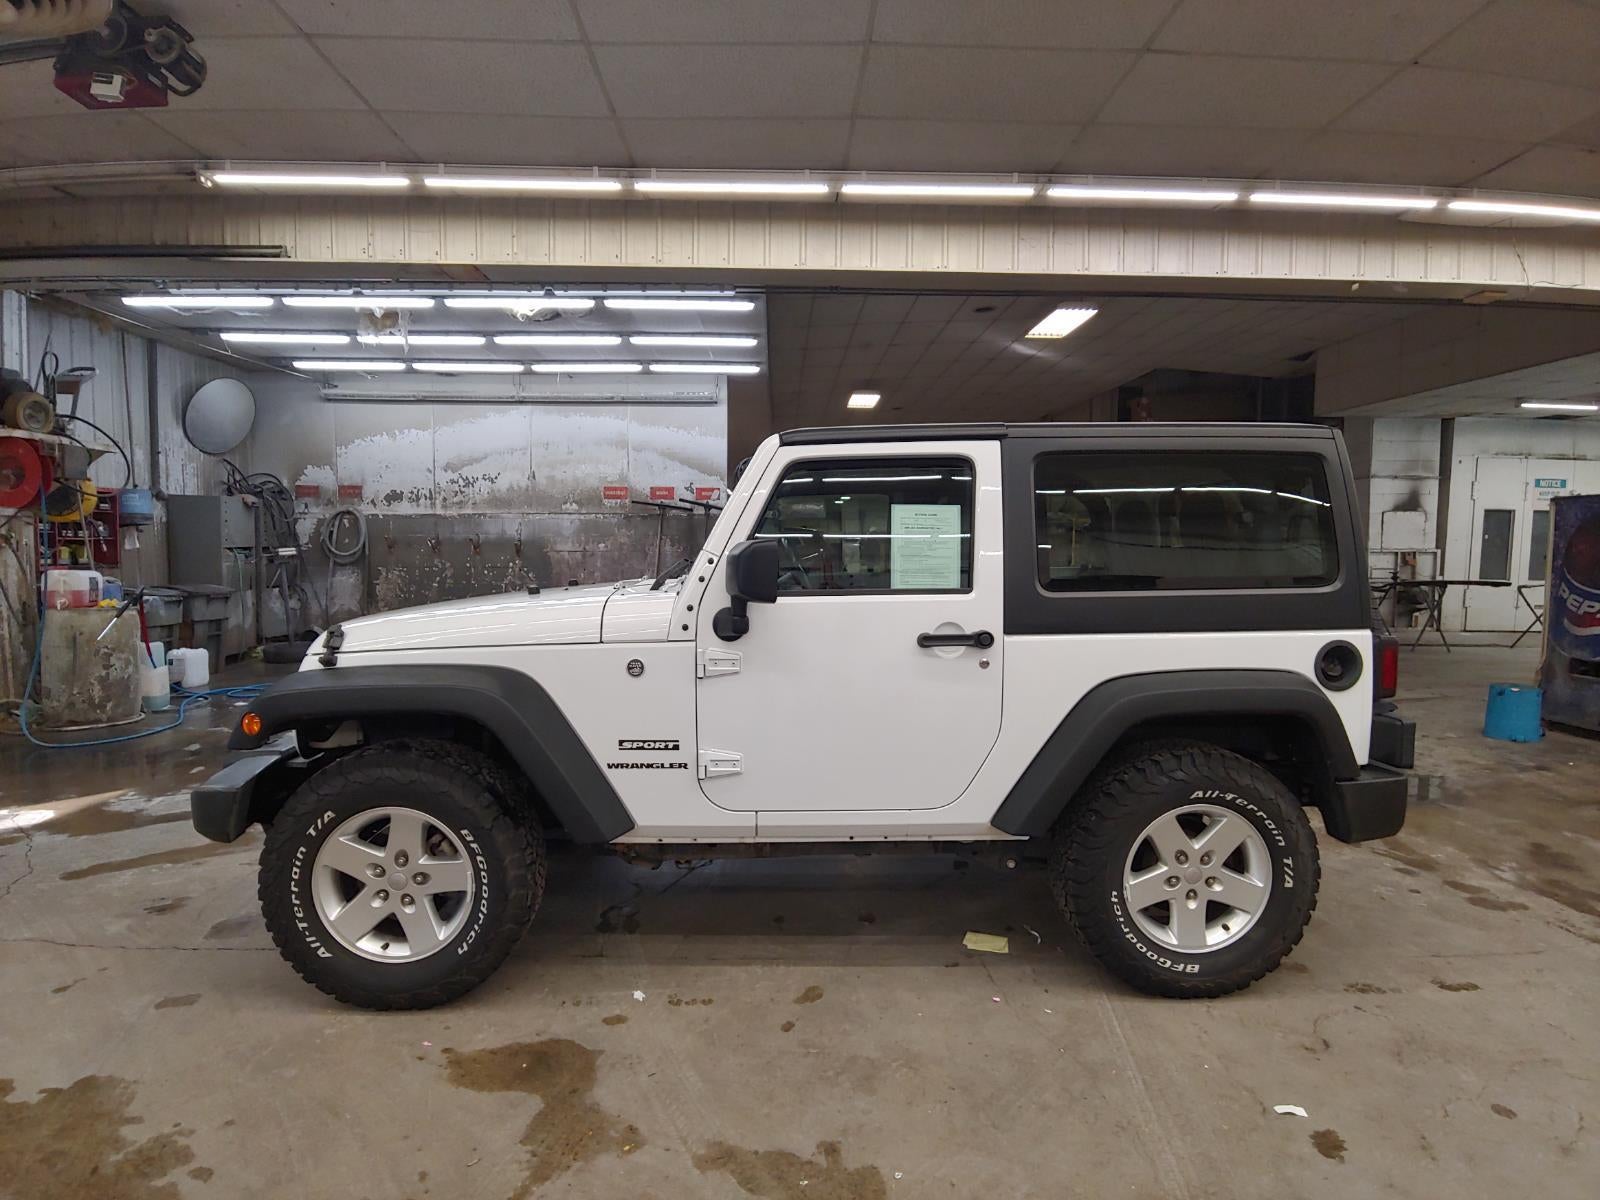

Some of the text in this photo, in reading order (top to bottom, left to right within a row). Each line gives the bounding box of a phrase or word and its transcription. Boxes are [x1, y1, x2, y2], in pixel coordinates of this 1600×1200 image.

[1539, 479, 1562, 488] NOTICE
[1558, 581, 1600, 617] PEP
[606, 762, 689, 770] WRANGLER
[618, 740, 680, 750] SPORT
[1189, 789, 1294, 889] All-Terrain T/A
[288, 809, 337, 959] All-Terrain T/A
[457, 828, 490, 956] BFGoodrich
[1109, 890, 1201, 974] BFGoodrich
